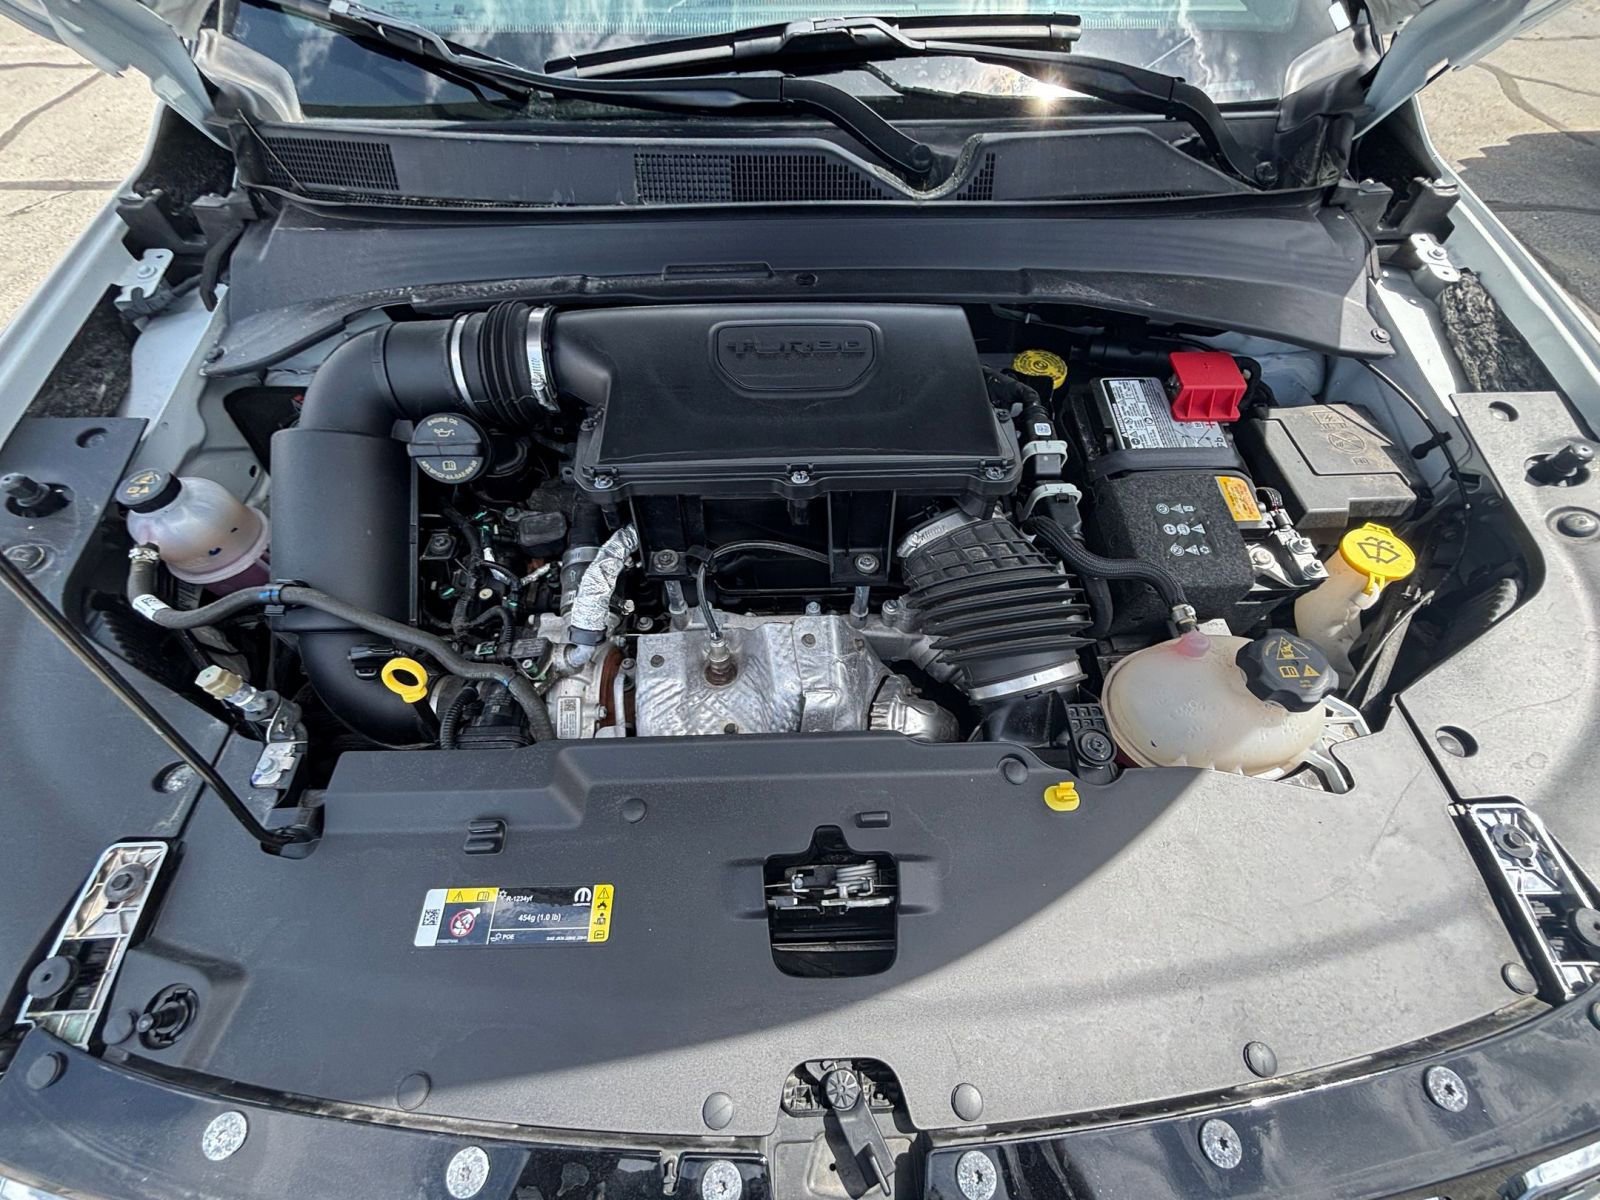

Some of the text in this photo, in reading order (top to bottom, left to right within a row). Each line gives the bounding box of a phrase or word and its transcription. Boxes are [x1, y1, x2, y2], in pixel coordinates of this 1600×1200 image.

[427, 417, 459, 426] ENGINE OIL
[505, 895, 534, 903] R-1234yf
[518, 913, 536, 923] 454g
[551, 913, 562, 922] lb)
